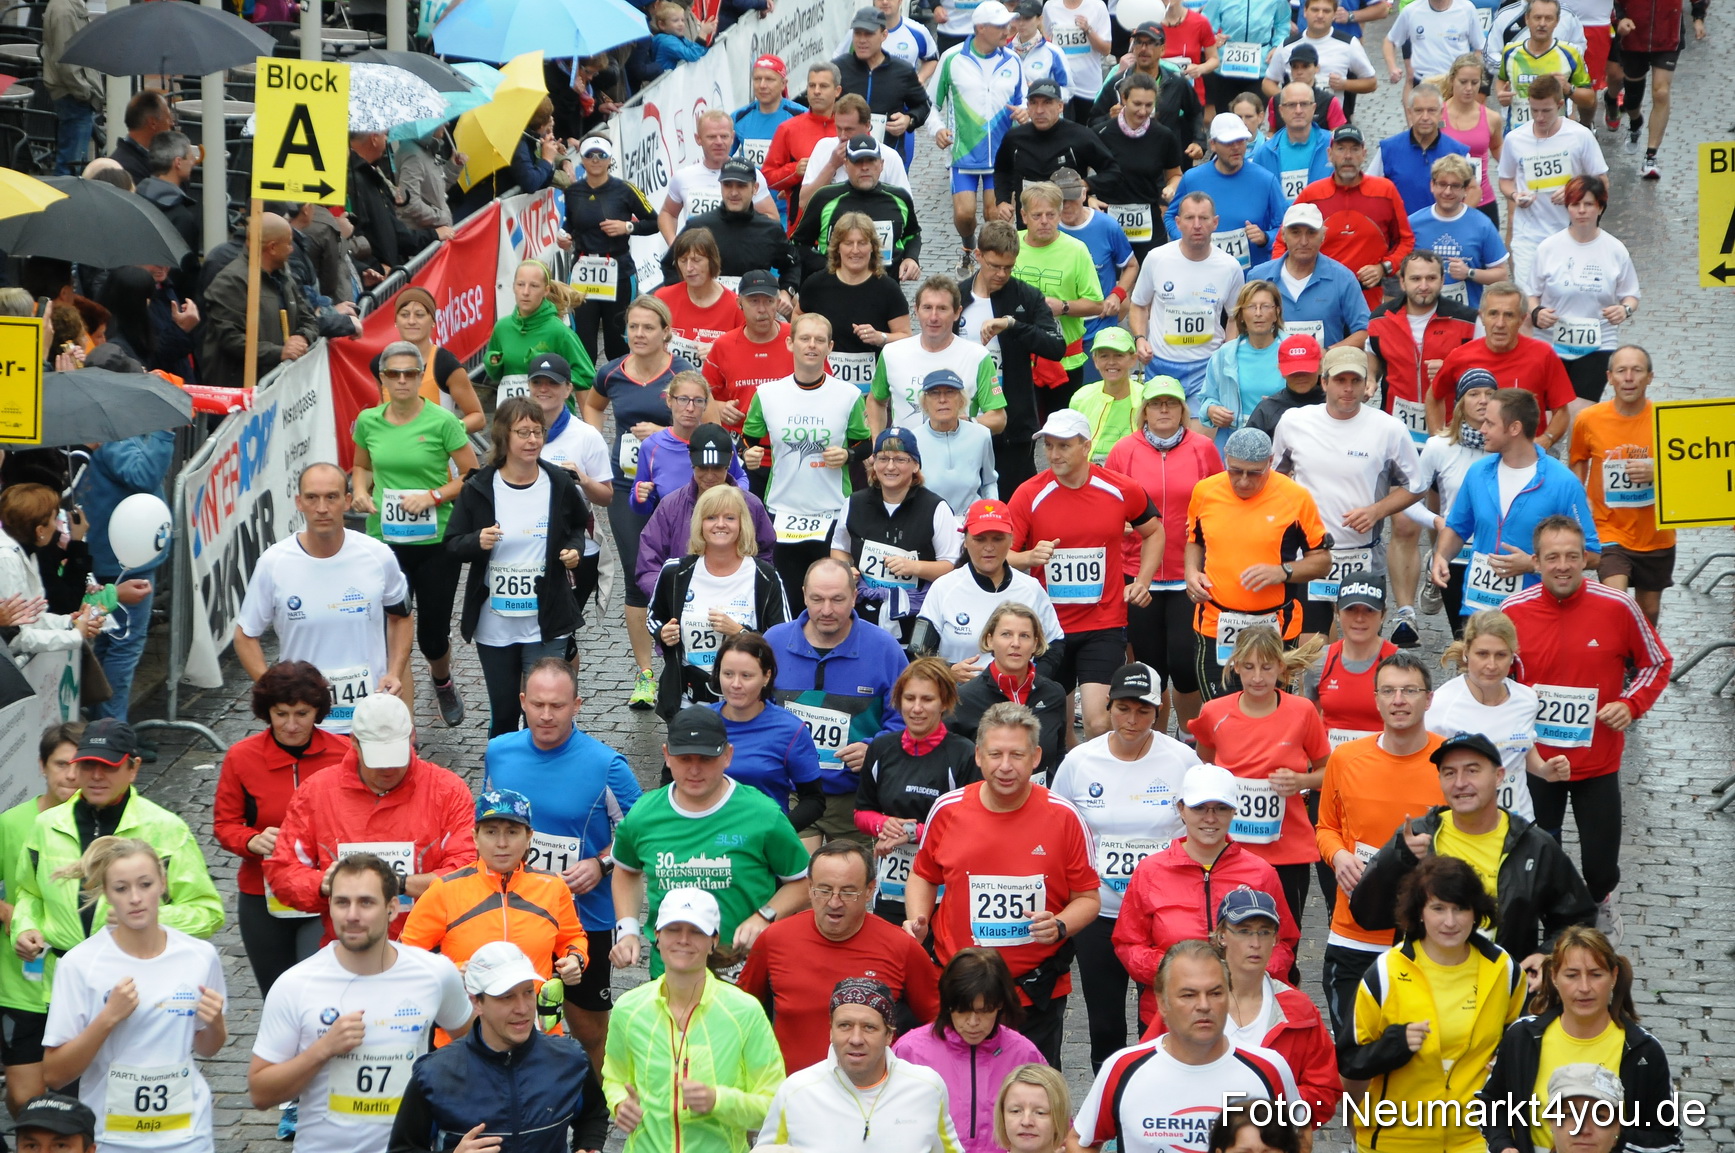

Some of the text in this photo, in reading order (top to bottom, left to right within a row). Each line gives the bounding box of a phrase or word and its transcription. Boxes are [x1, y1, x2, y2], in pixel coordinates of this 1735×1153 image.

[1056, 33, 1087, 46] 3153
[1226, 49, 1257, 63] 2361
[267, 64, 338, 92] Block
[273, 103, 326, 171] A
[1534, 160, 1563, 178] 535
[1116, 212, 1143, 227] 490
[579, 267, 608, 283] 310
[1175, 317, 1204, 332] 160
[1557, 327, 1596, 345] 2170
[832, 364, 872, 381] 2015
[788, 414, 824, 425] FÜRTH
[781, 427, 831, 446] 2013
[785, 515, 821, 531] 238
[1051, 562, 1100, 582] 3109
[1473, 566, 1517, 592] 2429
[1340, 582, 1382, 599] adidas
[505, 601, 532, 609] Renate
[1220, 617, 1240, 625] PARTL
[329, 673, 360, 682] Neumarkt
[806, 712, 837, 722] Neumarkt
[1536, 700, 1589, 725] 2202
[1543, 727, 1578, 738] Andreas
[1235, 795, 1280, 818] 398
[1235, 823, 1270, 834] Melissa
[533, 838, 566, 850] Neumarkt
[655, 852, 679, 869] 30.
[655, 867, 732, 878] REGENSBURGER
[657, 876, 733, 890] Altstadtlauf
[978, 893, 1036, 919] 2351
[363, 1053, 403, 1062] Neumarkt
[110, 1069, 179, 1082] PARTL Neumarkt
[356, 1066, 392, 1094] 67
[134, 1084, 168, 1112] 63
[352, 1100, 390, 1113] Martin
[135, 1119, 161, 1131] Anja
